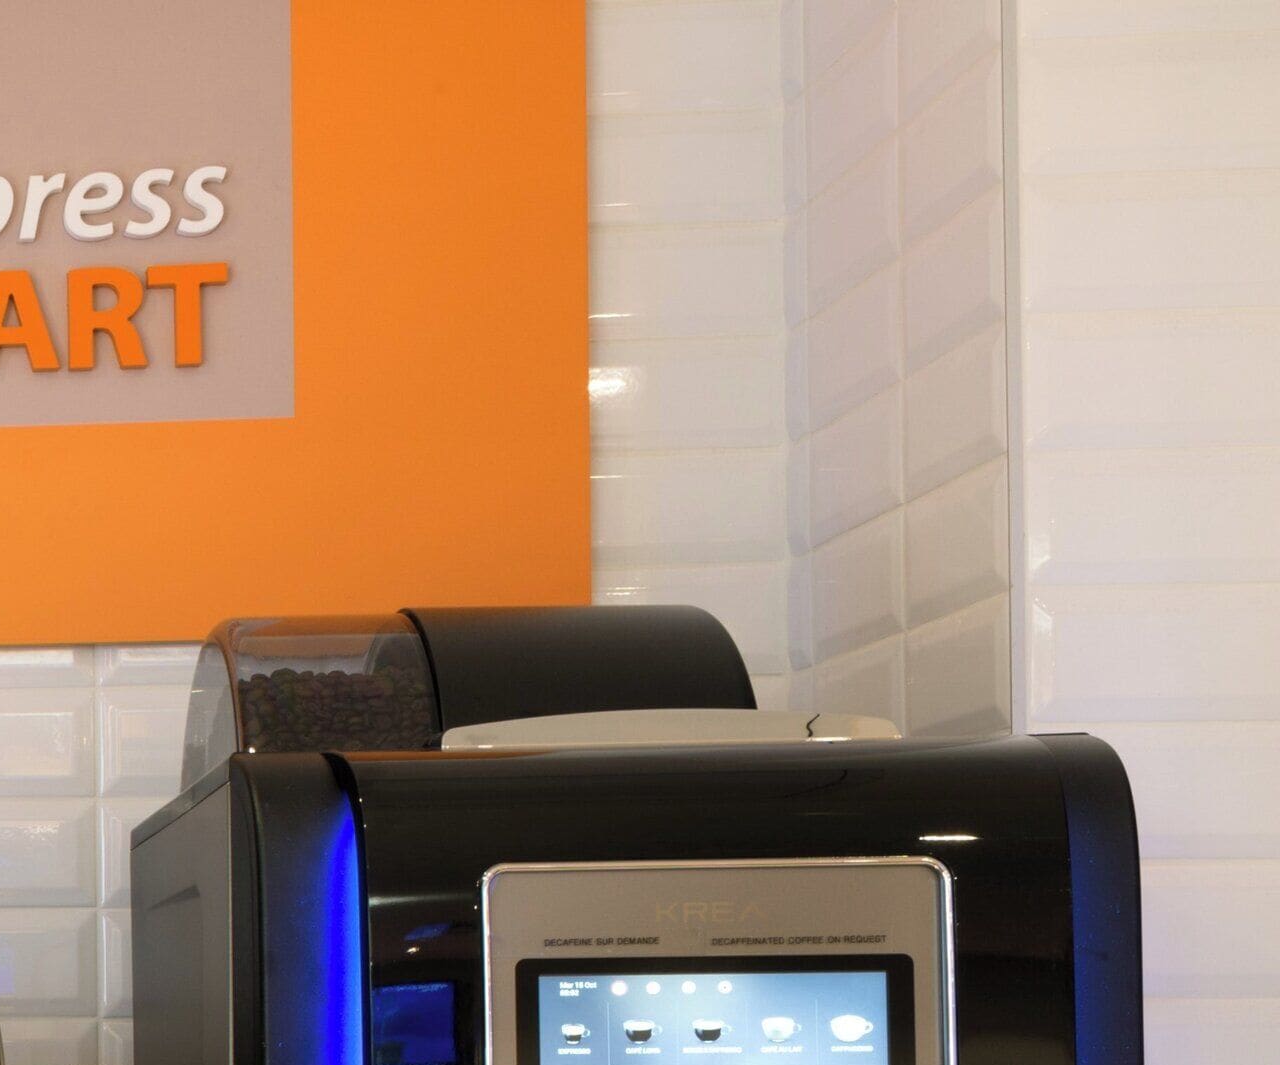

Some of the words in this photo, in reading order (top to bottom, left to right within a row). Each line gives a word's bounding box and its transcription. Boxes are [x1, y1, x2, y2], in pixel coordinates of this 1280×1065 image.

[654, 900, 770, 922] KREA
[543, 938, 593, 947] DECAFEINE
[595, 937, 615, 946] SUR
[617, 936, 660, 945] DEMANDE
[711, 936, 785, 946] DECAFFEINATED
[787, 935, 824, 945] COFFEE
[827, 935, 841, 944] ON
[843, 934, 887, 944] REQUEST
